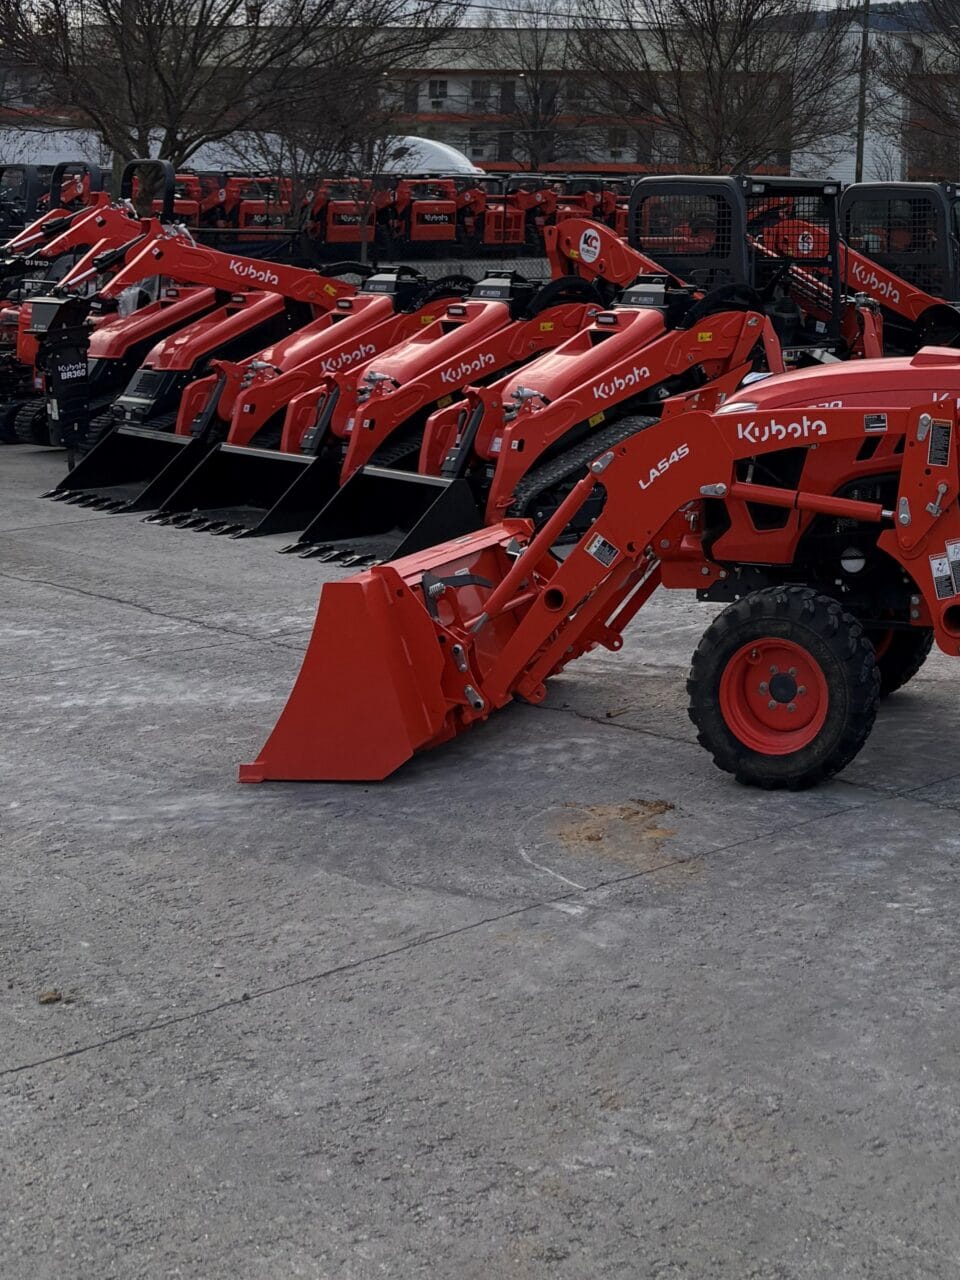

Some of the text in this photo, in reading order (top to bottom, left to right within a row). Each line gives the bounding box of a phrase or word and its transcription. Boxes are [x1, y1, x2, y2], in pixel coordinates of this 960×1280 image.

[583, 233, 599, 250] KC
[229, 259, 279, 286] Kubota
[852, 262, 900, 304] Kubota
[320, 343, 376, 373] Kubota
[440, 352, 496, 383] Kubota
[61, 369, 86, 380] BR360
[592, 366, 651, 399] Kubota
[737, 416, 827, 443] Kubota
[638, 443, 690, 490] LA545
